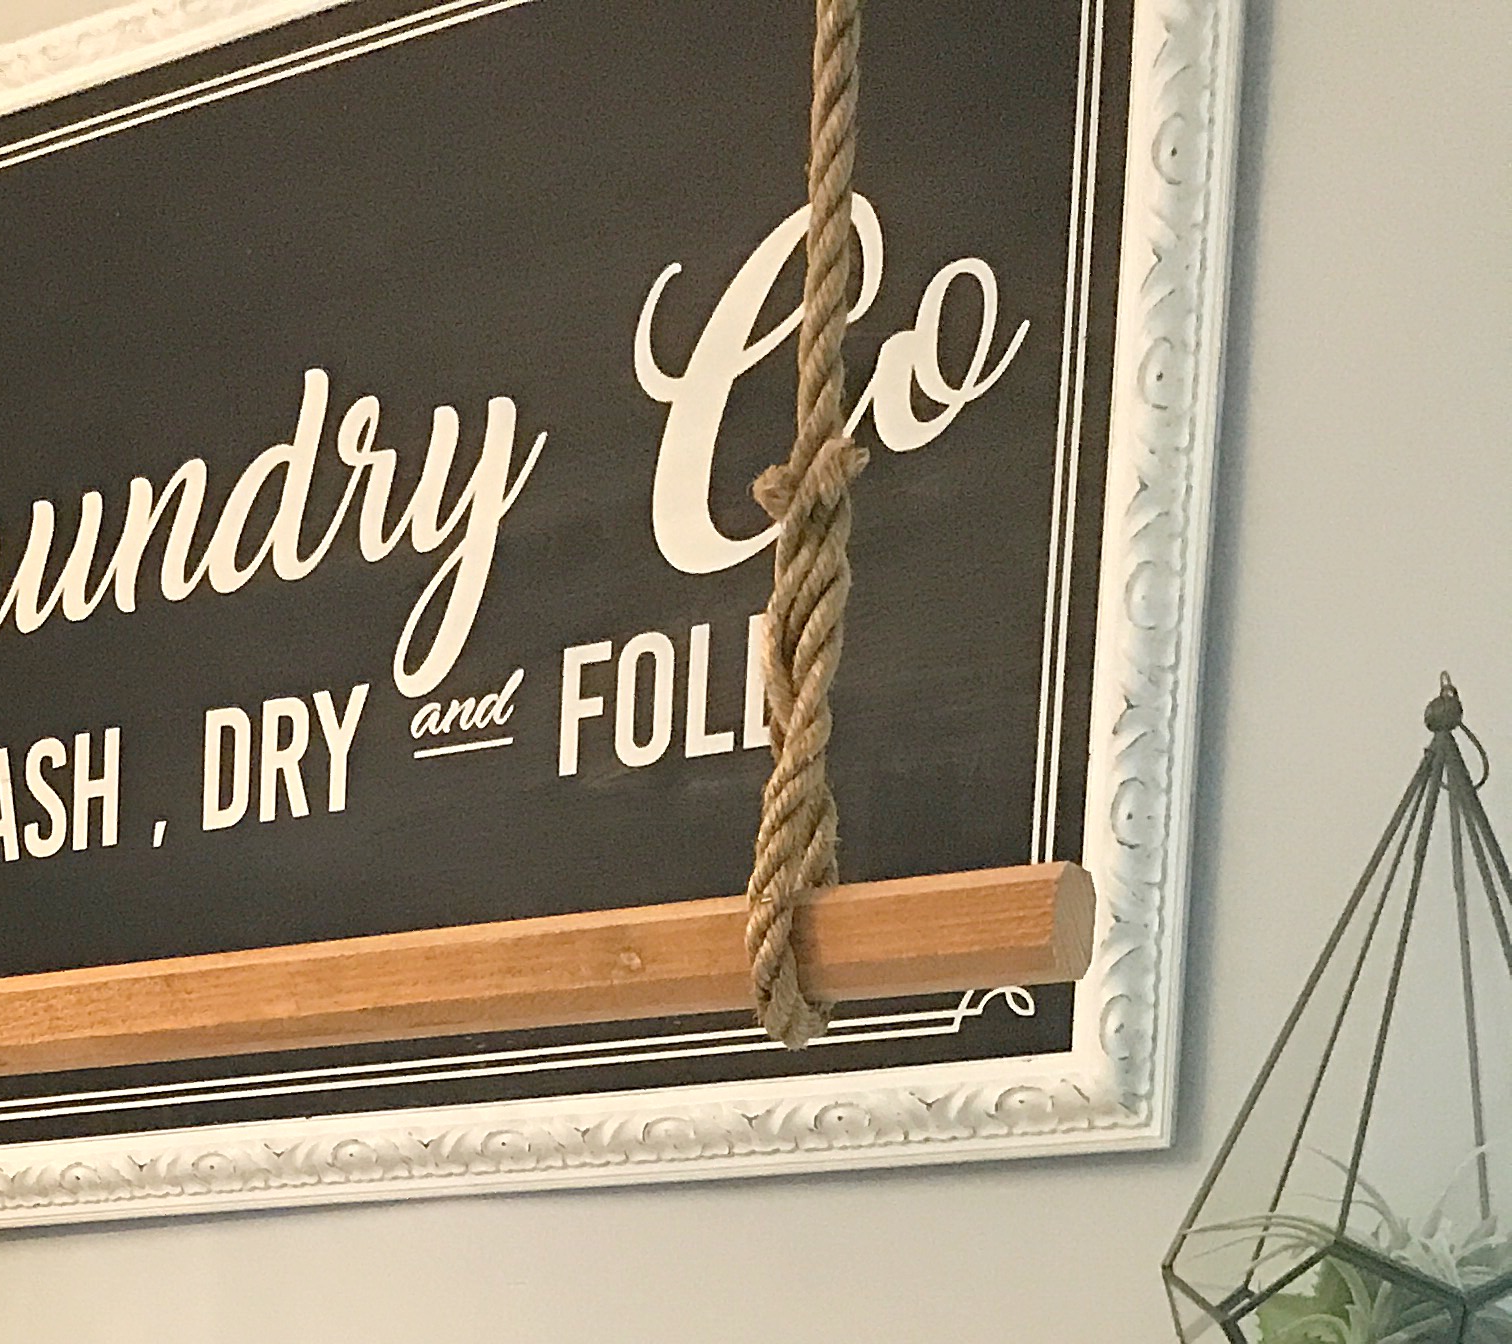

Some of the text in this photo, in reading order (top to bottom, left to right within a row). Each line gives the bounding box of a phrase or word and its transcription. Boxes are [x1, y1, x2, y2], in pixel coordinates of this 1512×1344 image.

[634, 193, 1029, 575] Co
[202, 684, 369, 831] DRY
[410, 668, 524, 739] and
